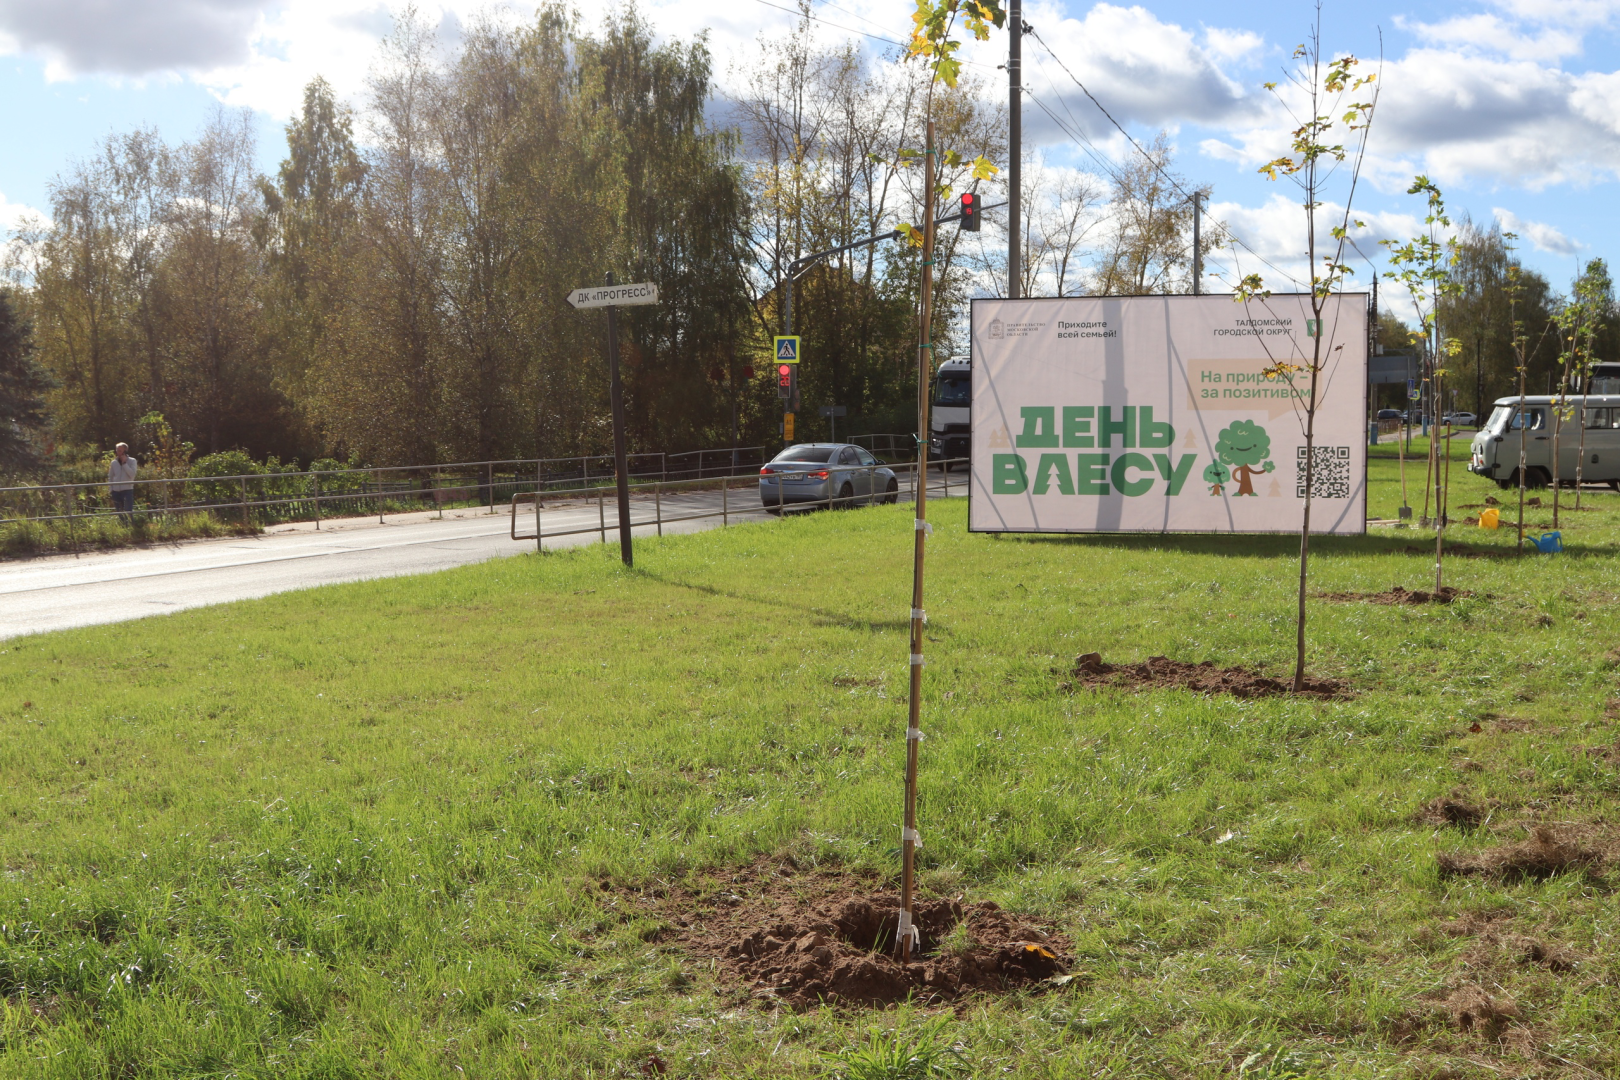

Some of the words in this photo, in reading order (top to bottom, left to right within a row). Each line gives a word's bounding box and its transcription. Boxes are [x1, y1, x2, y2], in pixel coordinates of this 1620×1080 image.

[577, 292, 590, 304] ДК
[591, 287, 651, 300] «ПРОГРЕСС»
[1057, 321, 1108, 330] Приходите
[1235, 318, 1292, 327] ТАЛДОМСКИЙ
[1057, 331, 1079, 339] всей
[1080, 329, 1117, 338] семьей!
[1213, 327, 1264, 337] ГОРОДСКОЙ
[1266, 328, 1292, 336] ОКРУГ
[1201, 370, 1222, 383] На
[1200, 388, 1219, 399] за
[1223, 388, 1311, 399] позитивом
[1016, 405, 1176, 448] ДЕНЬ
